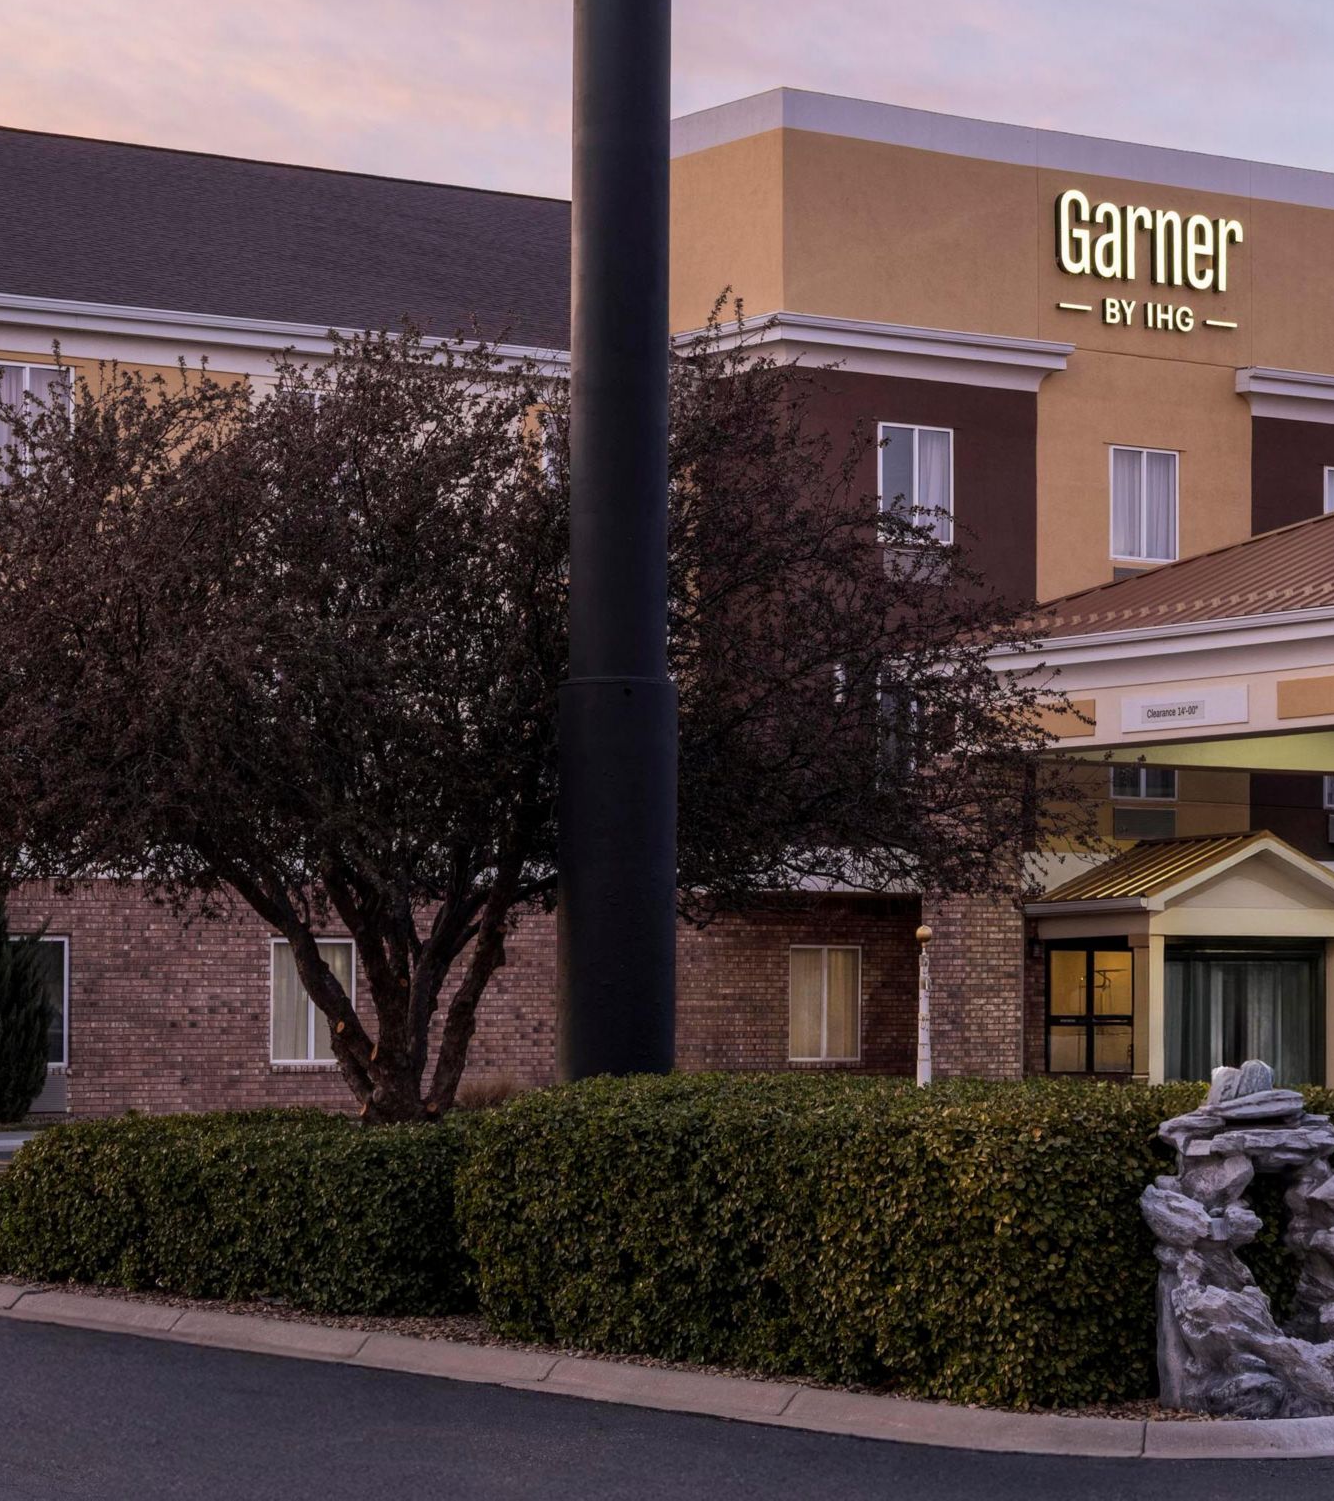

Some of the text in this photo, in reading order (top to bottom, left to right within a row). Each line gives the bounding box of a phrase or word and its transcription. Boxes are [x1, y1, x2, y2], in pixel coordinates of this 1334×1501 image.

[1056, 189, 1243, 292] Garner
[1103, 298, 1195, 332] BY IHG
[1147, 708, 1176, 719] Clearance
